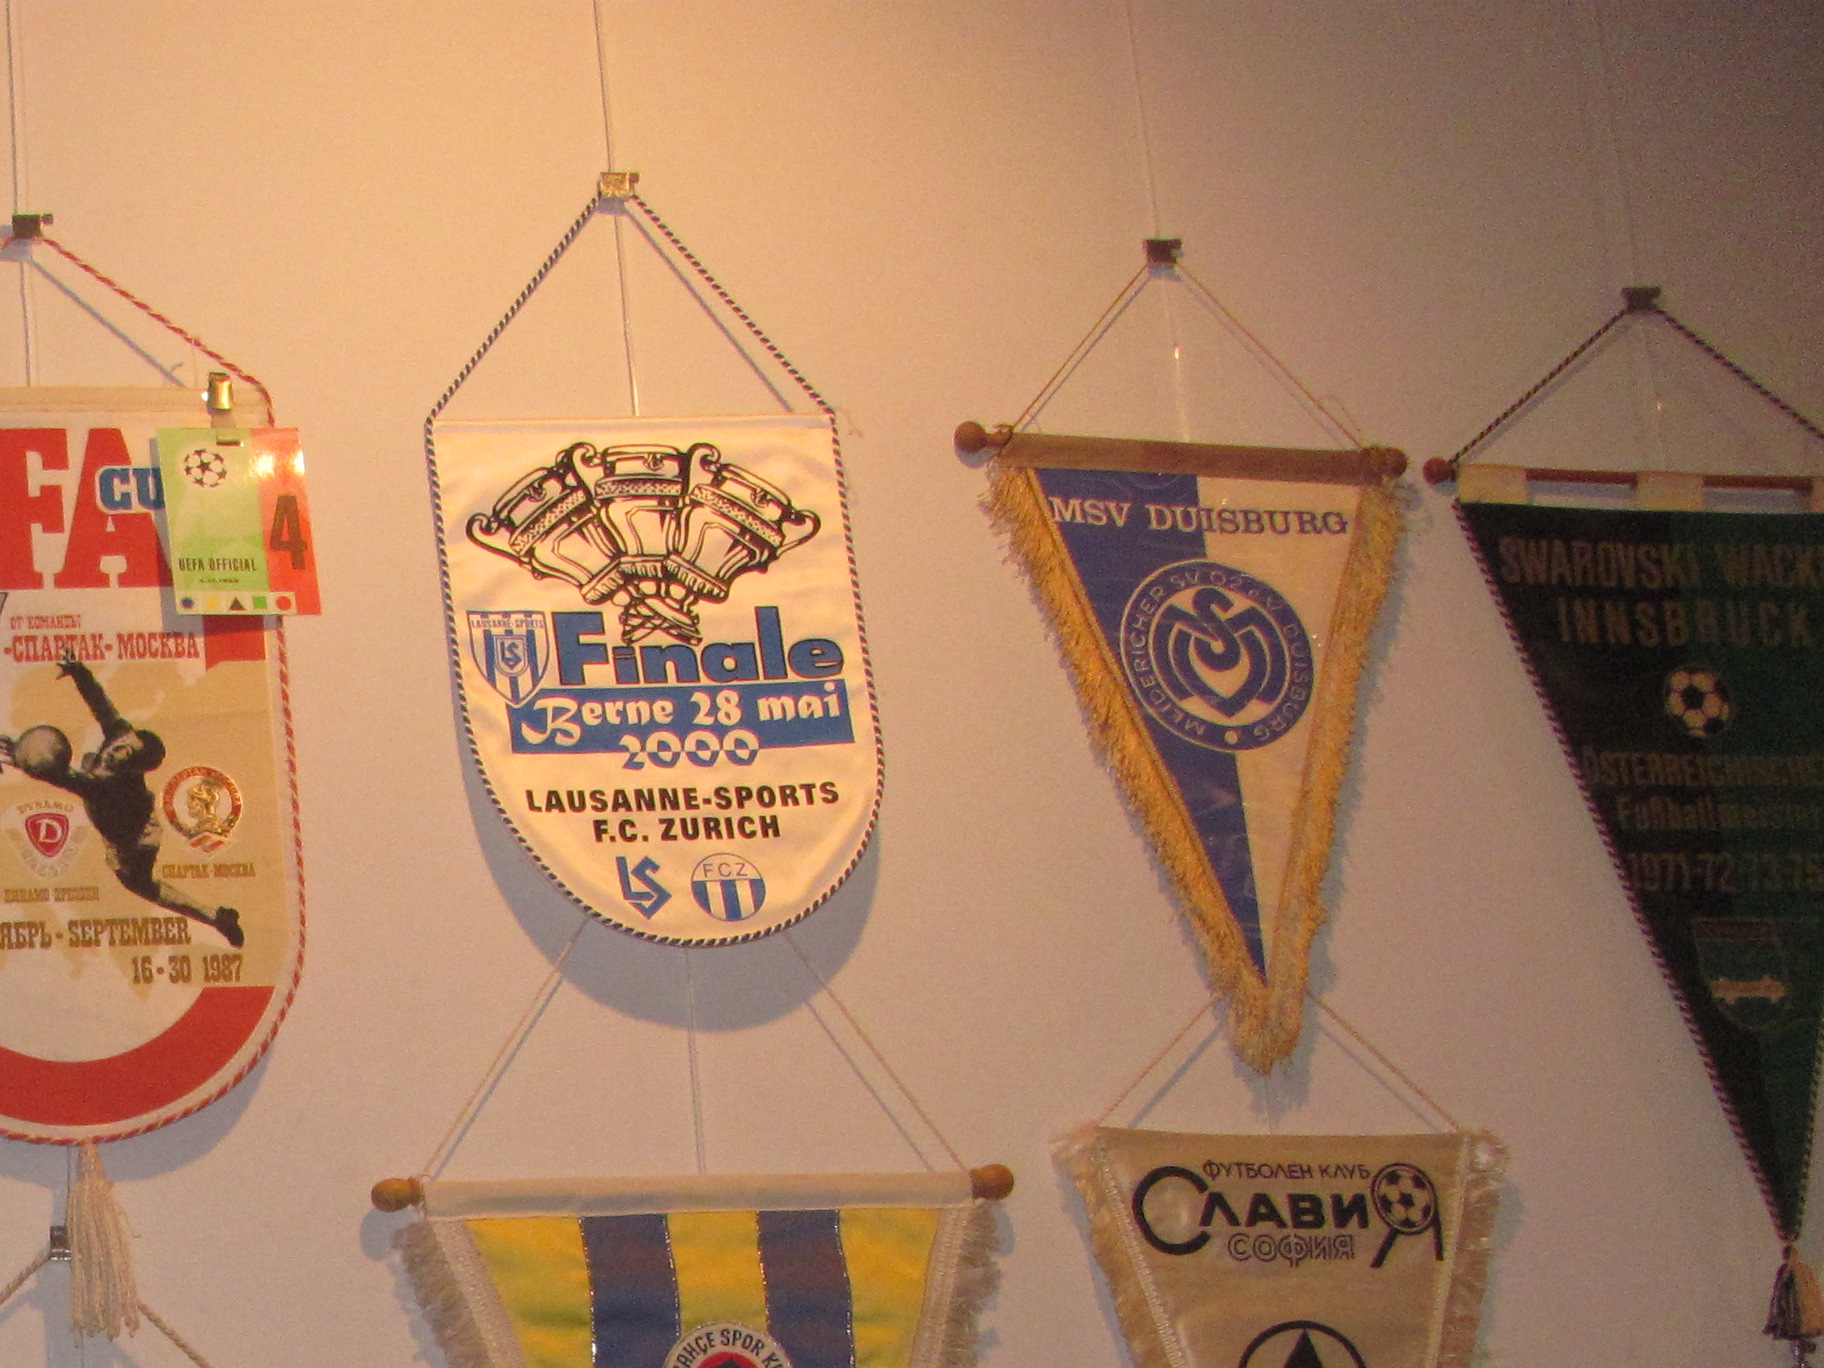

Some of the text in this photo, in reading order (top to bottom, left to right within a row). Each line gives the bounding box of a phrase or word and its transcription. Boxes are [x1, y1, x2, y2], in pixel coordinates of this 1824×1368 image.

[98, 466, 166, 513] CU
[269, 494, 308, 571] 4
[1048, 497, 1348, 534] MSV DUISBURG
[178, 557, 258, 573] UEFA OFFICIAL
[1498, 537, 1703, 589] SWAROVSKI
[1558, 595, 1816, 649] INNSBRUCK
[116, 632, 201, 660] МОСКВА
[551, 605, 844, 687] Finale
[1130, 586, 1205, 737] MEIDERICHER
[1170, 571, 1200, 587] SV
[1209, 571, 1244, 591] 02
[1253, 621, 1307, 742] DUISBURG
[522, 680, 842, 747] Berne 28 mai
[621, 729, 760, 771] 2000
[525, 781, 840, 813] LAUSANNE-SPORTS
[593, 815, 781, 843] F.C. ZURICH
[68, 915, 191, 947] SEPTEMBER
[202, 953, 243, 983] 1987
[1202, 1159, 1372, 1181] ФУТБОЛЕН КЛУБ
[1227, 1232, 1356, 1268] СОФИЯ
[719, 1328, 766, 1357] SPOR
